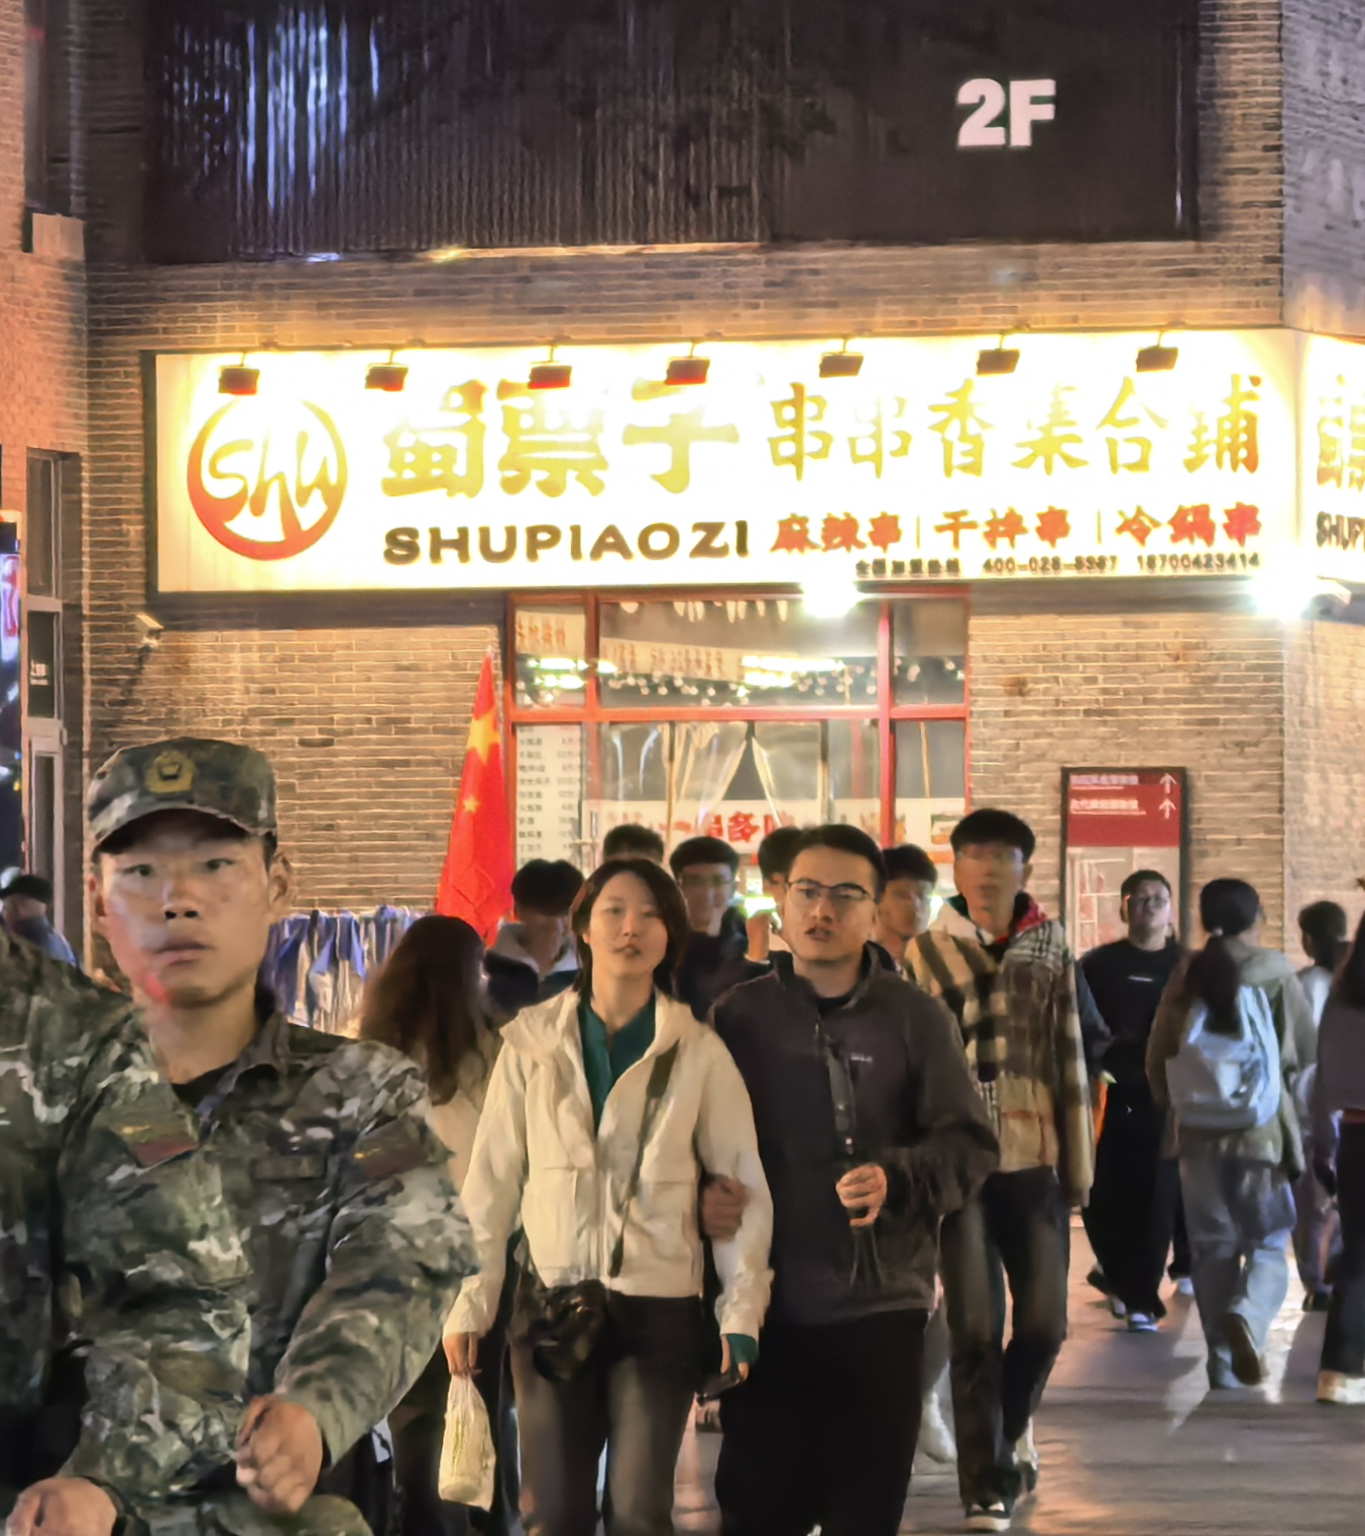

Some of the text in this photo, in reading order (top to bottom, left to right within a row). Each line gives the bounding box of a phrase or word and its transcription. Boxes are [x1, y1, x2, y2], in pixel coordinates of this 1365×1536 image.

[957, 78, 1057, 147] 2F
[382, 519, 750, 566] SHUPIAOZI
[769, 511, 903, 555] 麻辣串
